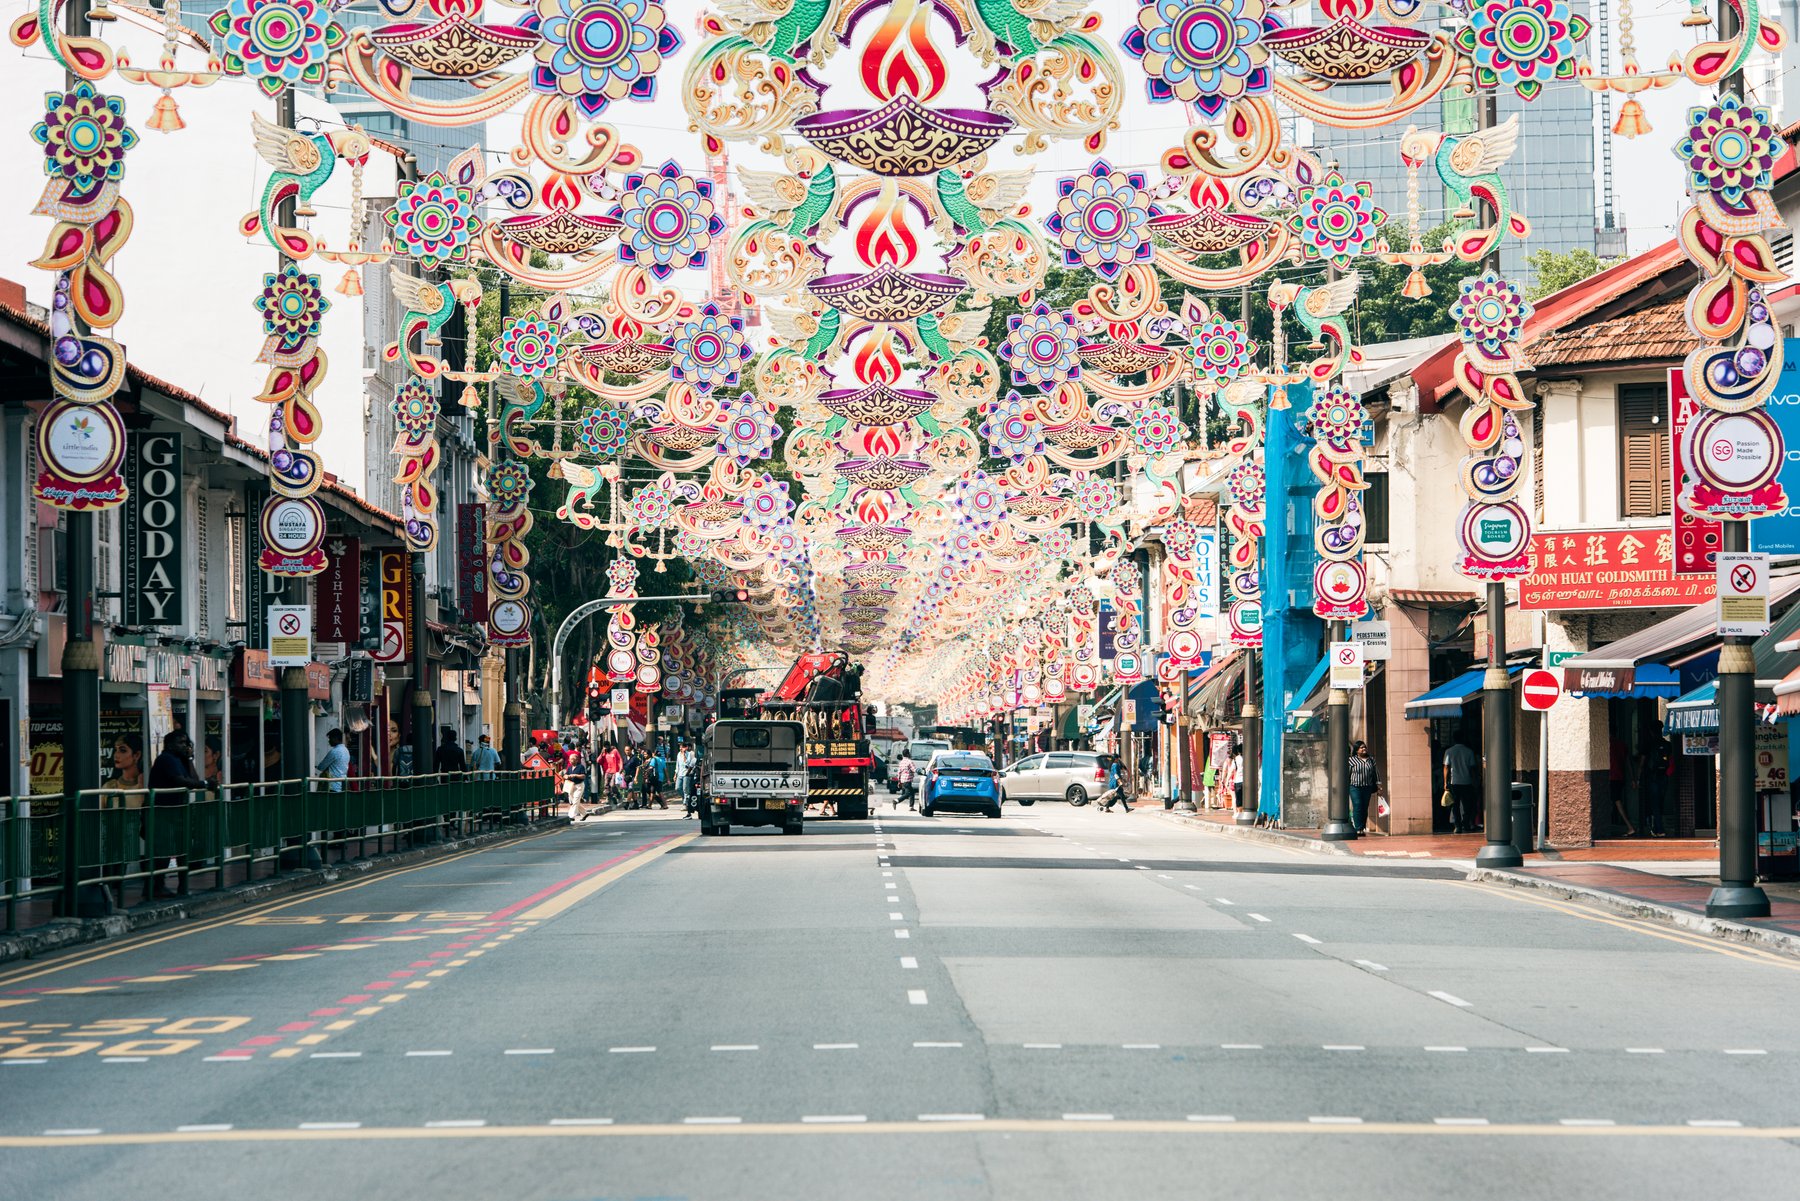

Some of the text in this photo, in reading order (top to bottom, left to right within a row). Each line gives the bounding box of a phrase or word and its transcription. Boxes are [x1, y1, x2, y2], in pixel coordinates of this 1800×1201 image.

[1716, 446, 1730, 455] SG
[128, 476, 136, 530] Personal
[142, 437, 176, 620] GOODAY
[128, 534, 136, 568] About
[128, 572, 136, 588] All
[1525, 574, 1558, 586] SOON
[1561, 572, 1593, 584] HUAT
[1596, 570, 1668, 583] GOLDSMITH
[332, 558, 342, 638] ISHTARA
[360, 576, 370, 634] STUDIO
[30, 723, 46, 732] TOP
[1768, 768, 1786, 781] 4G
[731, 778, 790, 788] TOYOTA
